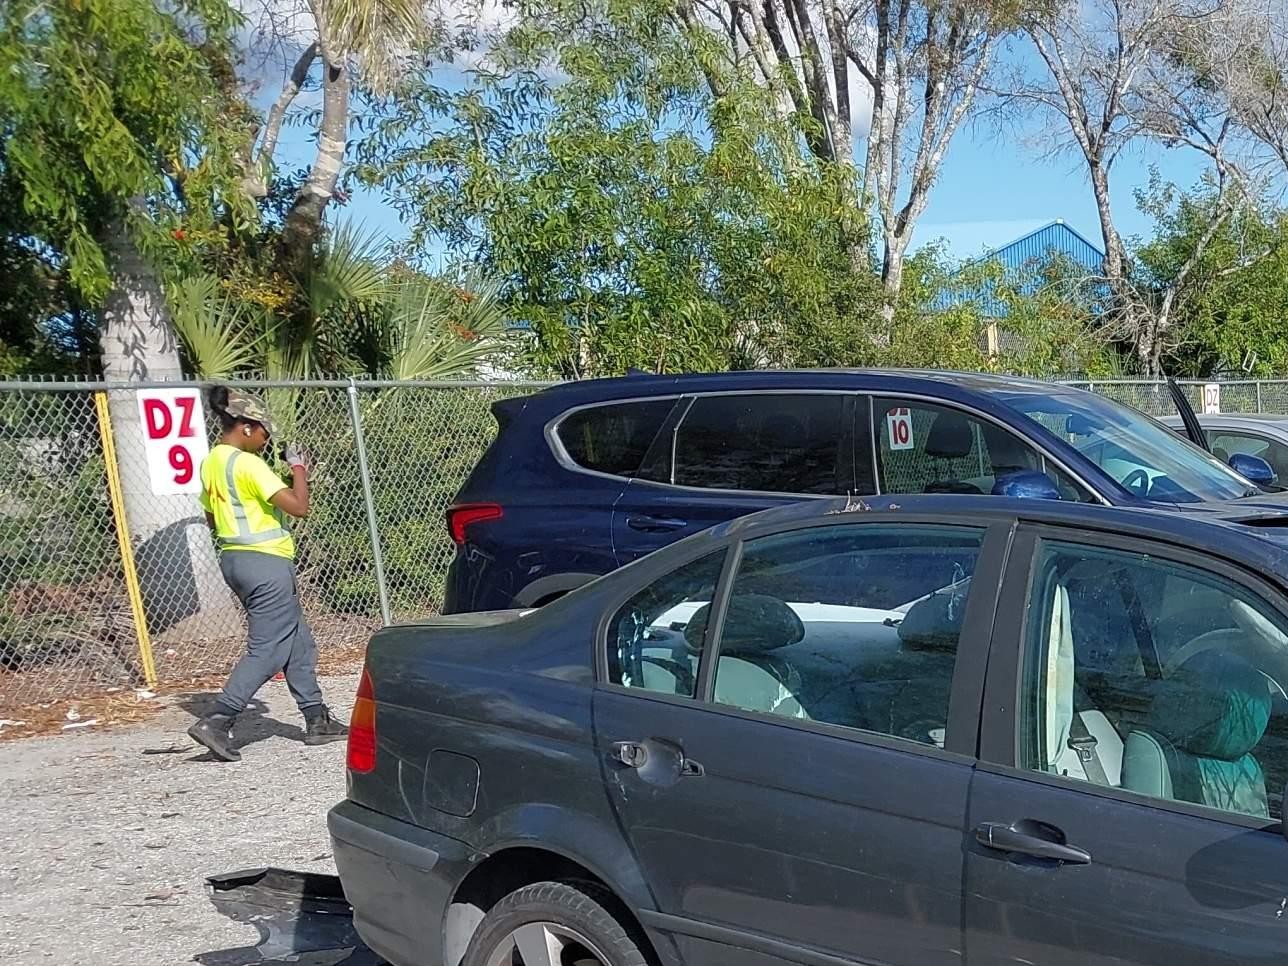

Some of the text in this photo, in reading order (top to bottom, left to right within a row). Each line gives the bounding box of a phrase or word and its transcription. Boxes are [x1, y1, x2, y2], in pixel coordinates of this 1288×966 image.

[1206, 388, 1218, 406] DZ
[143, 397, 196, 439] DZ
[891, 419, 910, 445] 10
[168, 444, 194, 485] 9
